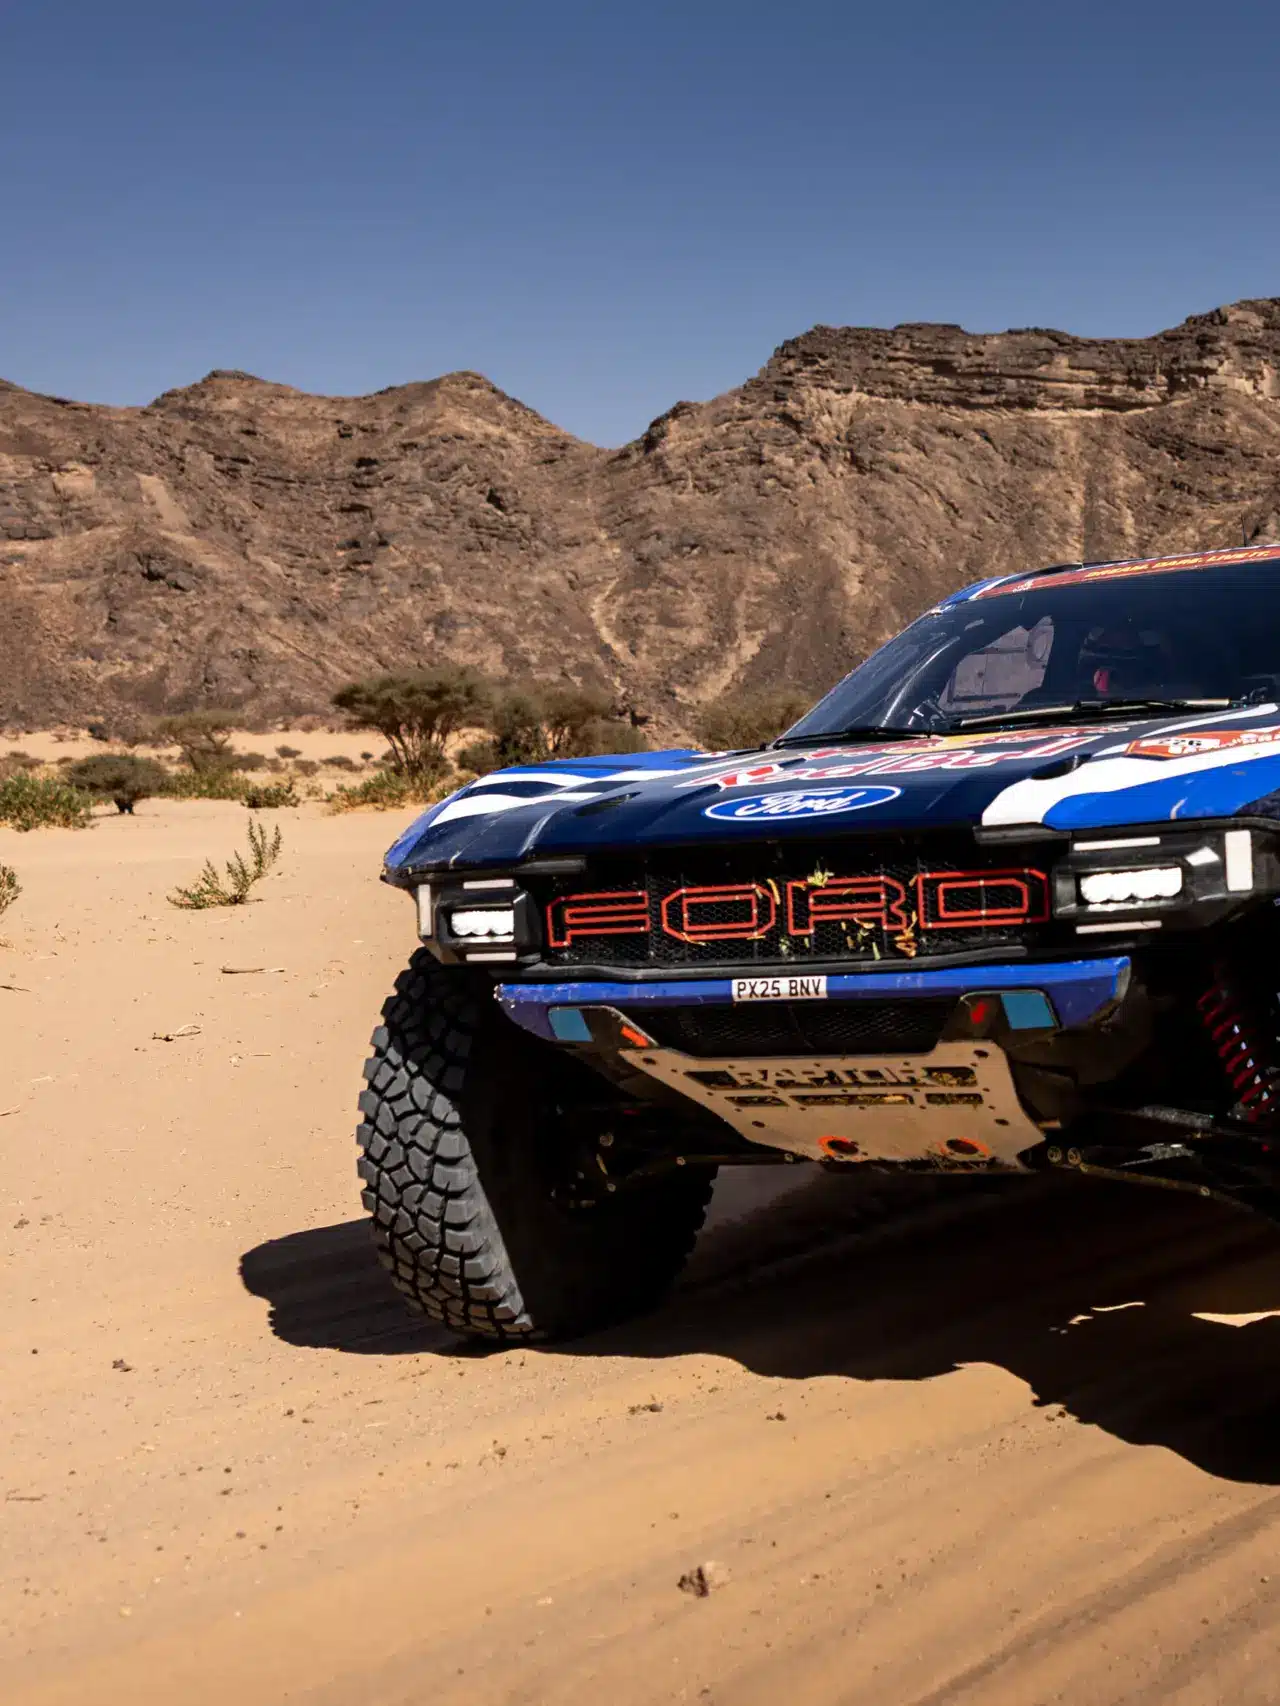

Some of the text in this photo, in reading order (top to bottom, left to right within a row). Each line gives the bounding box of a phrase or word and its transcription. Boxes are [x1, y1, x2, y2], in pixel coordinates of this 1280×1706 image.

[735, 789, 866, 816] Ford
[547, 867, 1049, 947] FORD
[736, 979, 822, 999] PX25 BNV
[731, 1066, 939, 1090] RAPTOR
